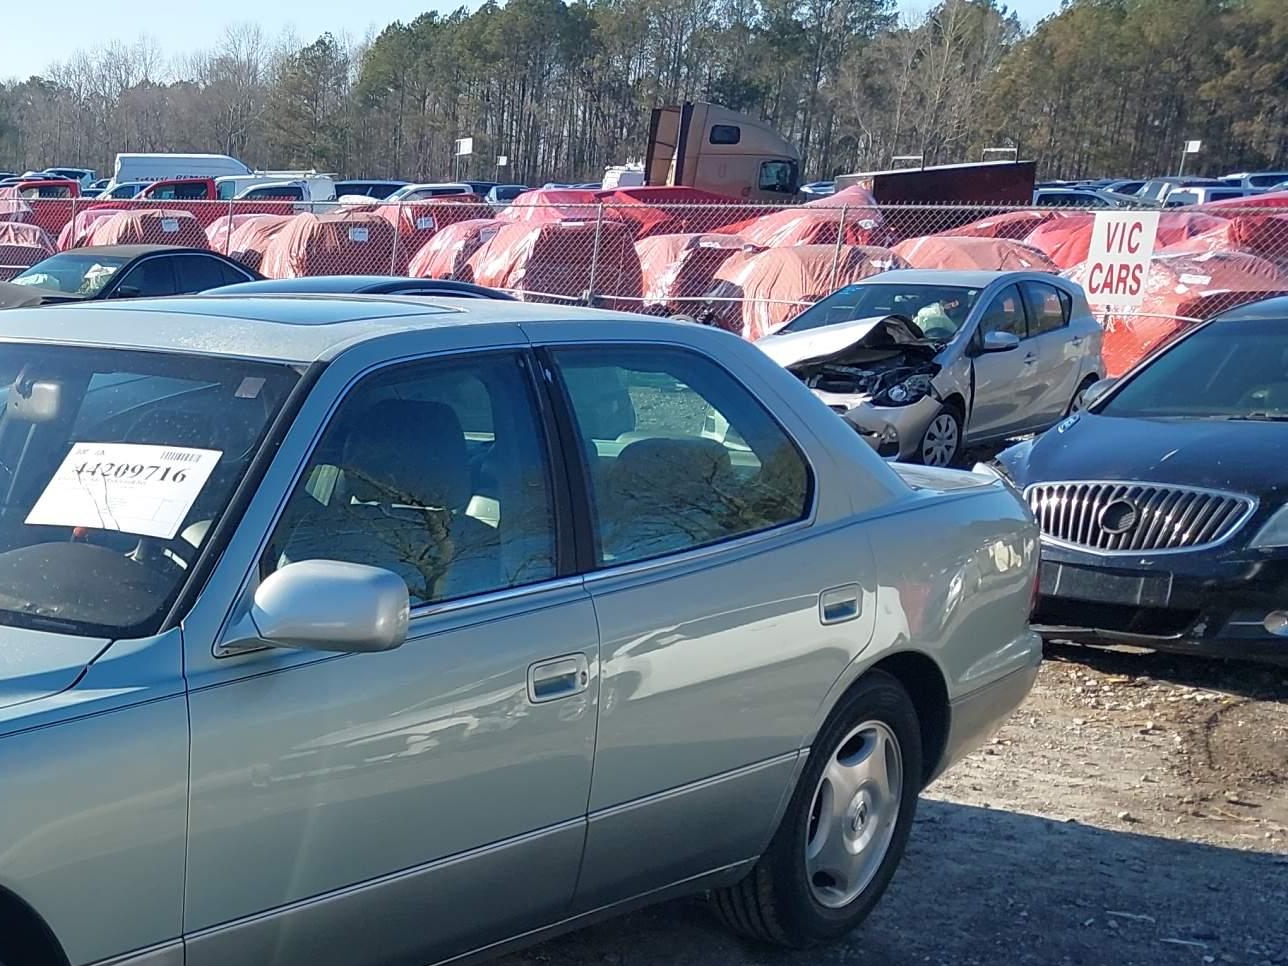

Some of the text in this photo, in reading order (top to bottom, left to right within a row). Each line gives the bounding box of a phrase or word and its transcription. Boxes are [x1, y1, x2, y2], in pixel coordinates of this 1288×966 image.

[1106, 222, 1143, 253] VIC
[1088, 262, 1143, 296] CARS
[73, 461, 191, 484] 44209716
